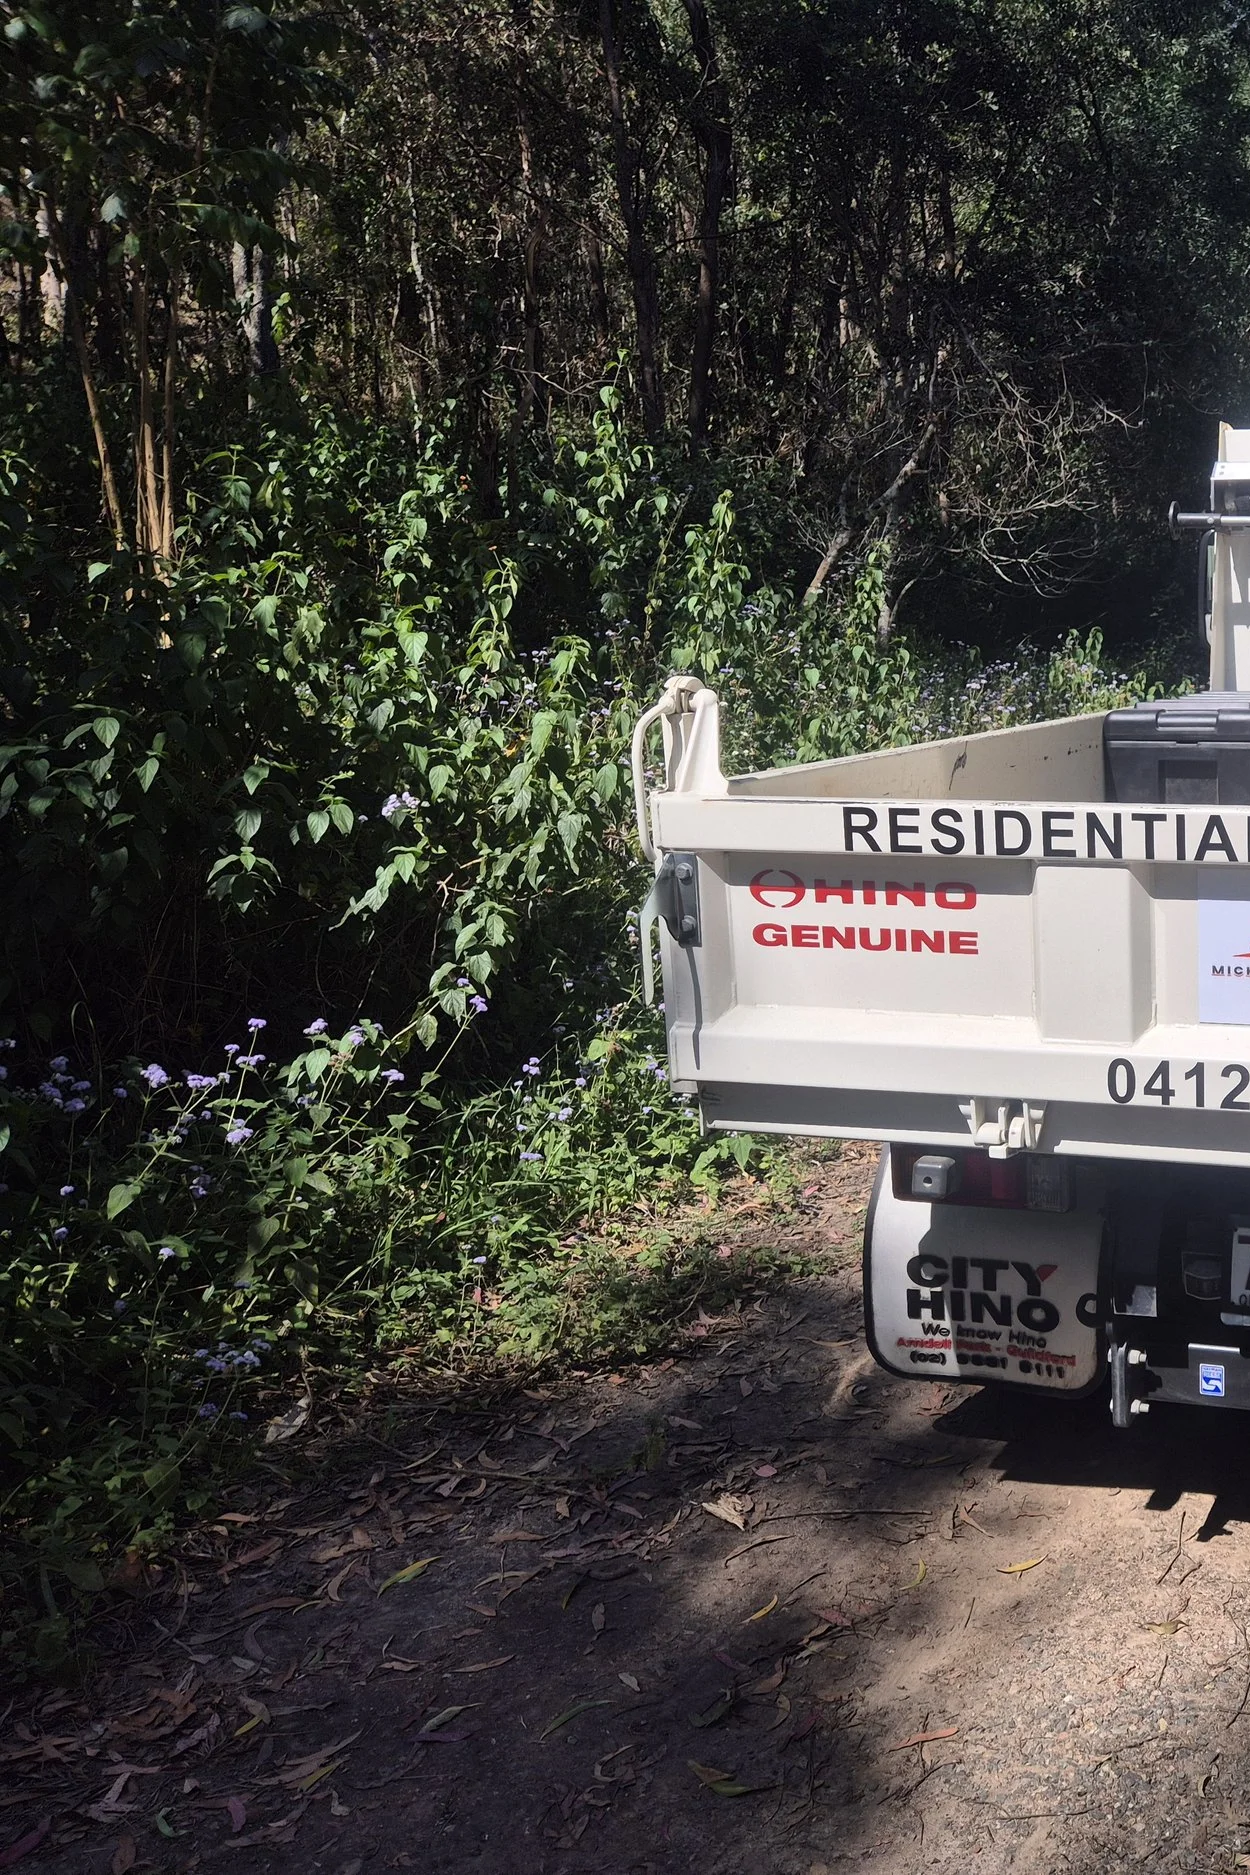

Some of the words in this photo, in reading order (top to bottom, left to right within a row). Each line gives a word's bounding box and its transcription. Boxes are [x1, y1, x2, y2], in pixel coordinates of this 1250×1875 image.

[814, 879, 977, 910] HINO
[752, 923, 979, 955] GENUINE
[1107, 1058, 1250, 1110] 0412
[906, 1254, 1058, 1296] CITY
[906, 1288, 1060, 1333] HINO
[921, 1322, 950, 1337] We
[957, 1324, 1002, 1341] know
[1009, 1330, 1047, 1348] Hino
